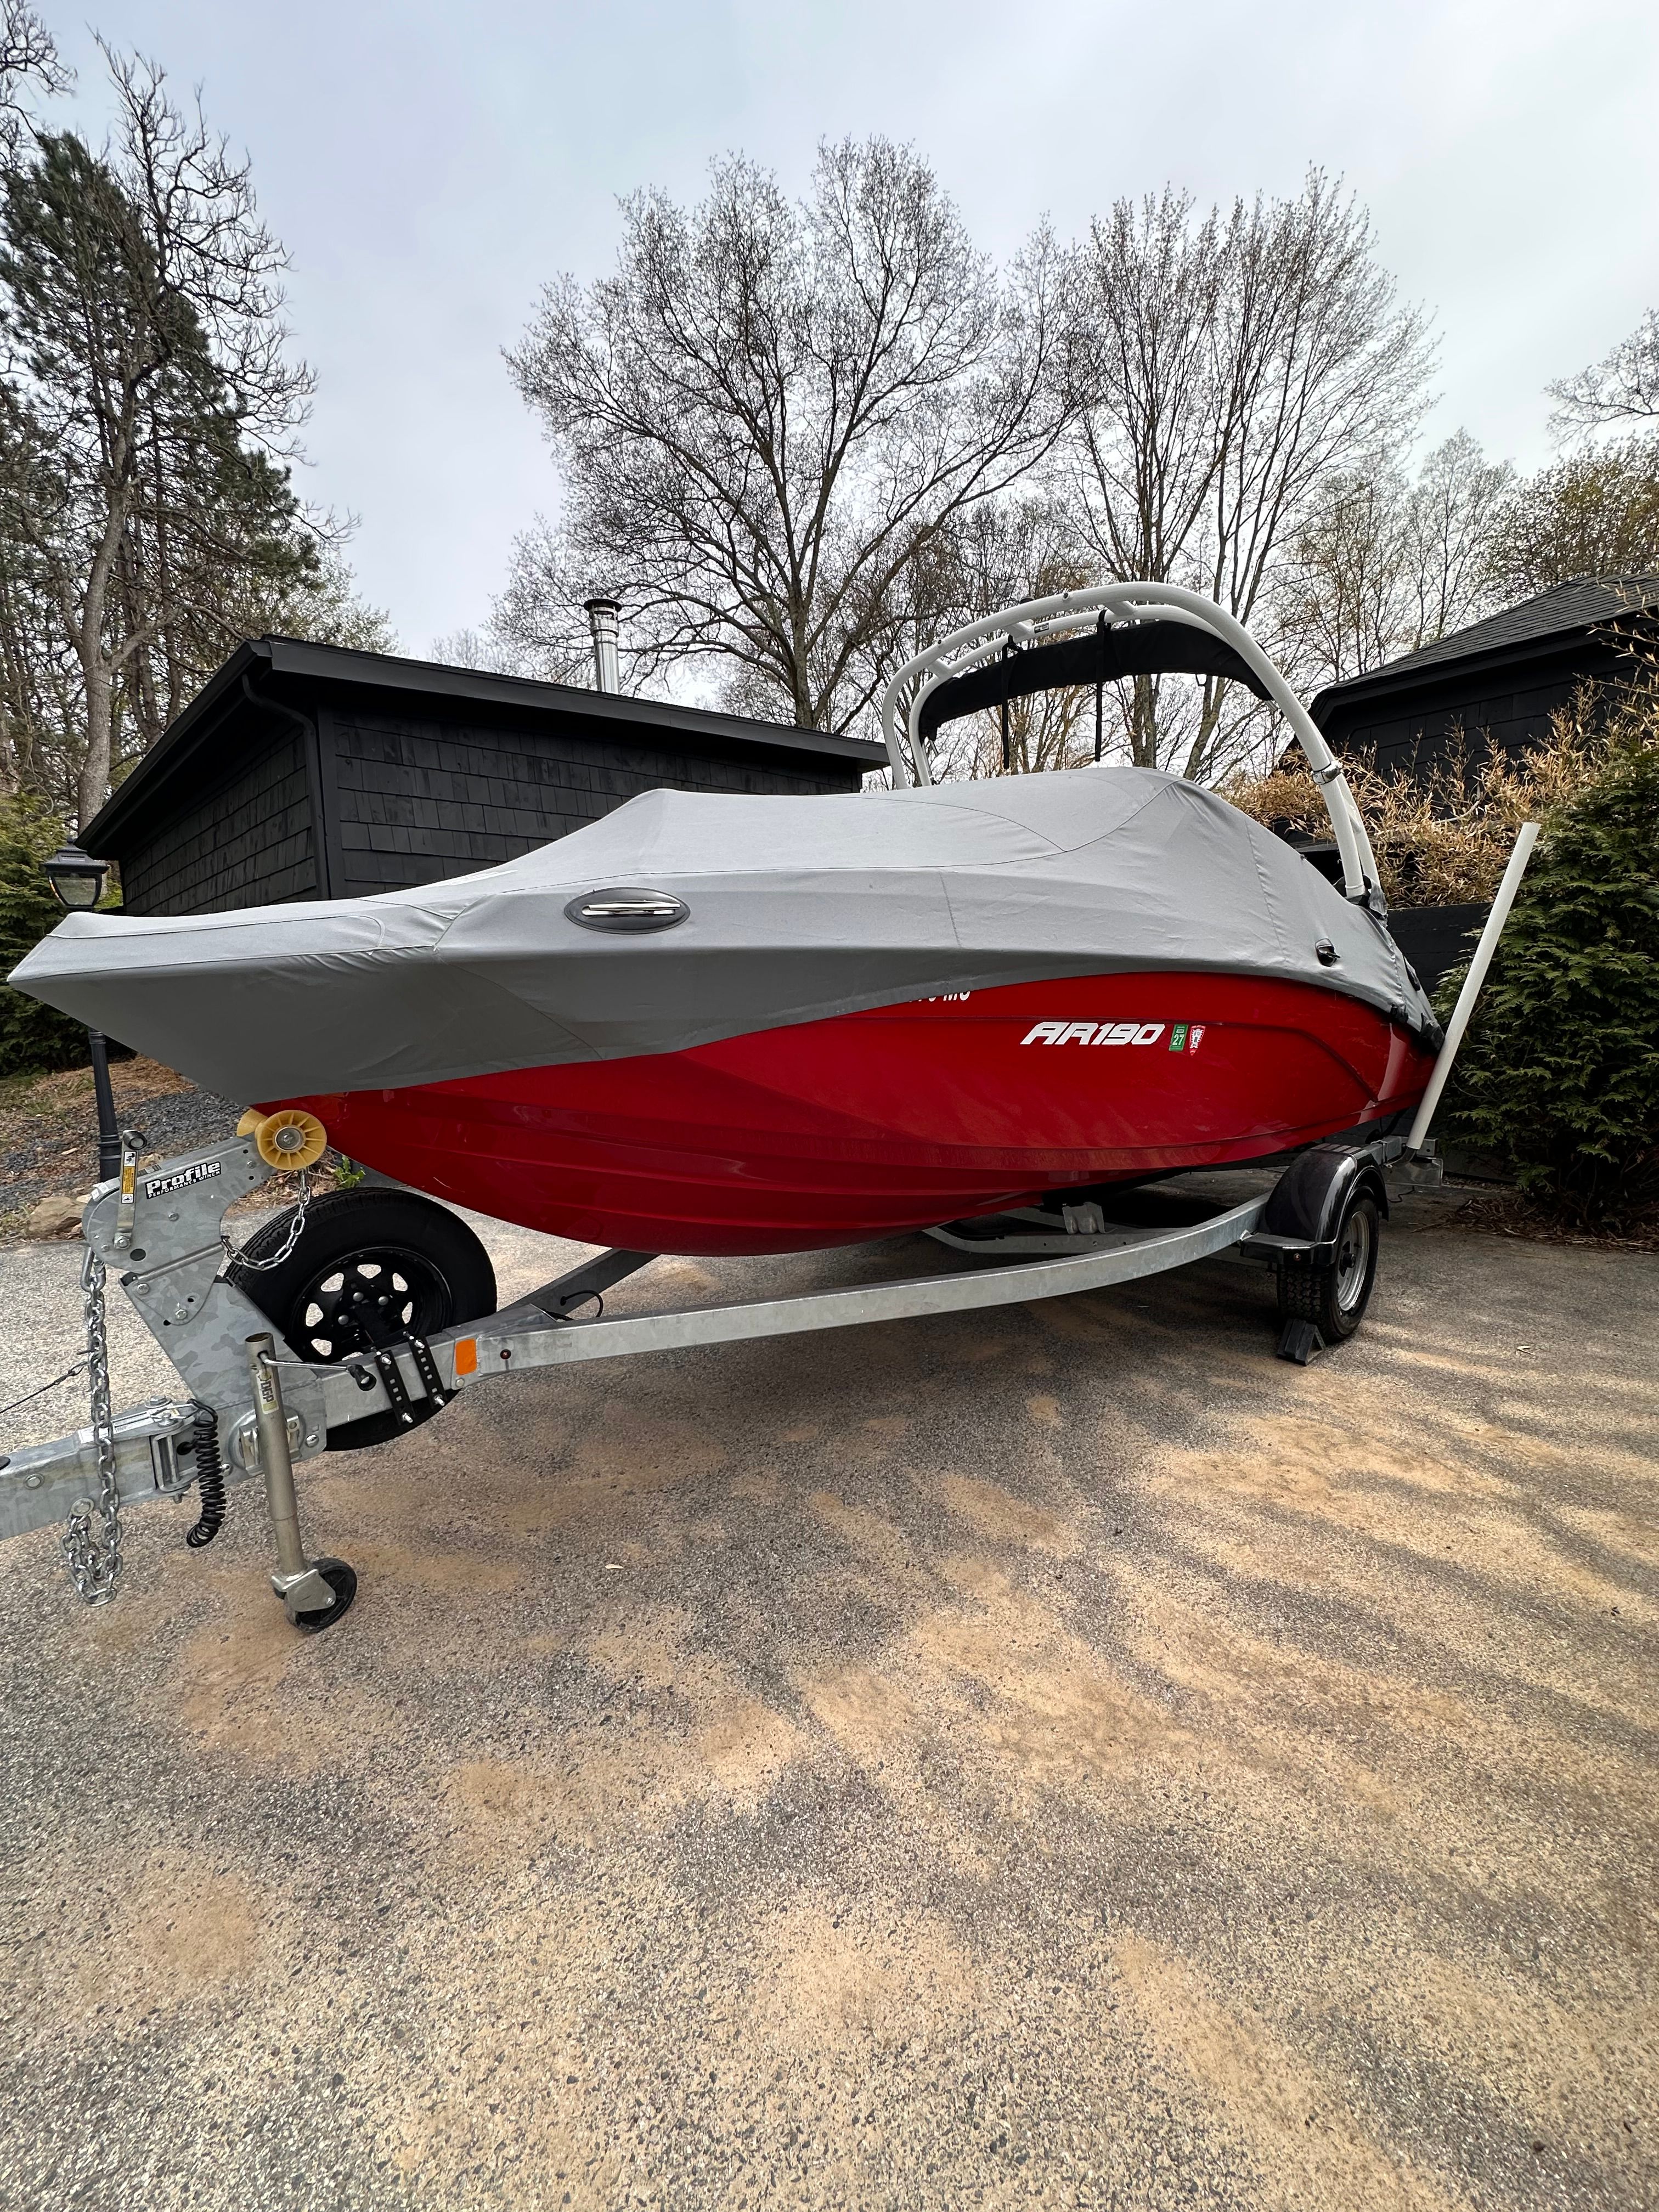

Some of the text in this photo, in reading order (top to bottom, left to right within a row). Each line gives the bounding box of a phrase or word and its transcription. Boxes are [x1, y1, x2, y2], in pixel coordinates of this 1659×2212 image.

[1020, 1022, 1165, 1045] AR190
[1172, 1034, 1186, 1046] 27
[146, 1163, 221, 1195] Profile
[149, 1178, 196, 1198] PERFORMANCE
[199, 1170, 221, 1181] WINCH
